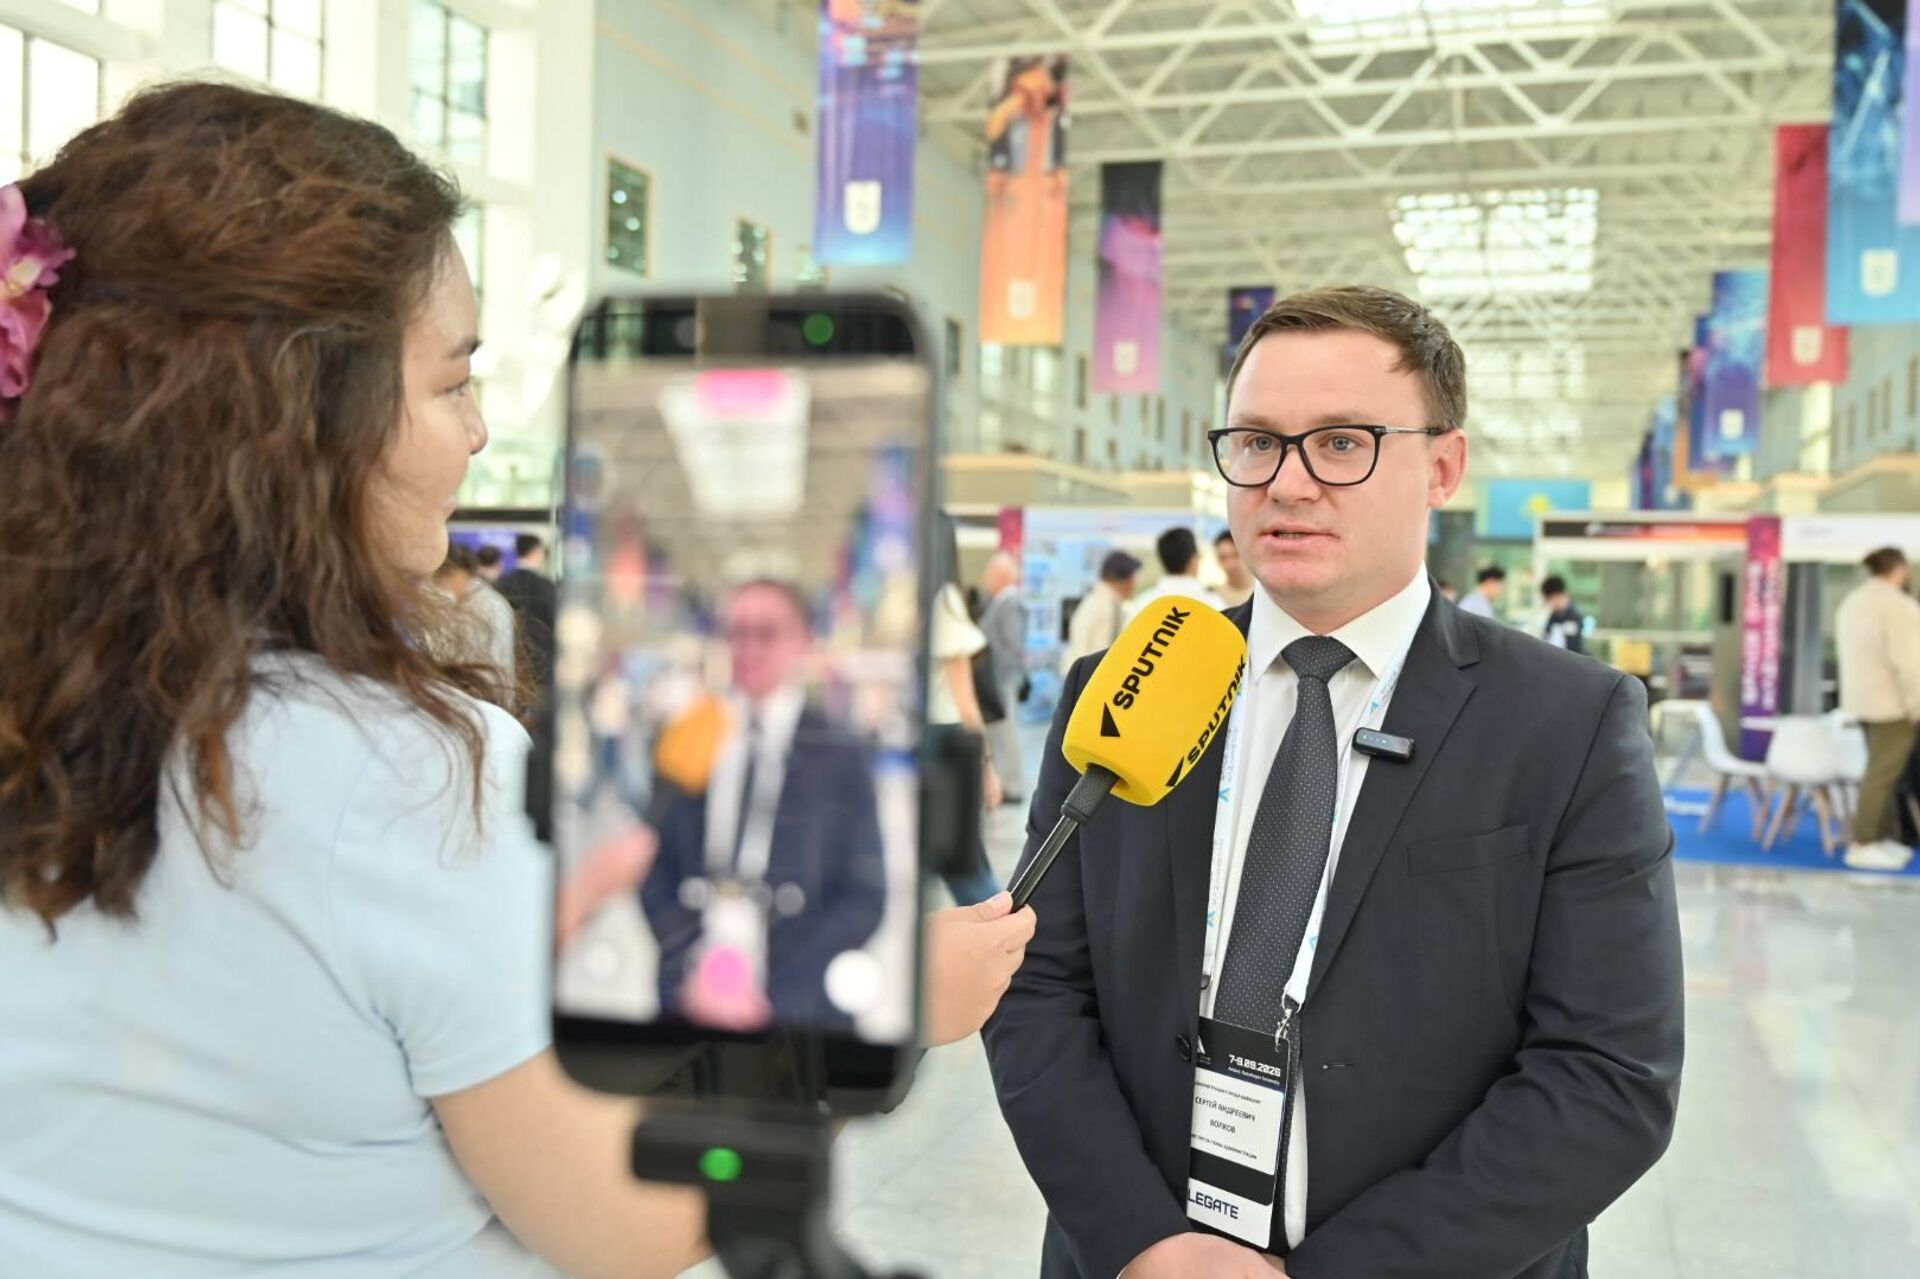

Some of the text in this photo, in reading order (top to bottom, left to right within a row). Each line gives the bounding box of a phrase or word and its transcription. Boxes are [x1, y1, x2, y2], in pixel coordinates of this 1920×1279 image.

[1112, 606, 1191, 710] SPUTNIK
[1188, 654, 1246, 765] SPUTNIK
[1188, 1189, 1239, 1220] LEGATE
